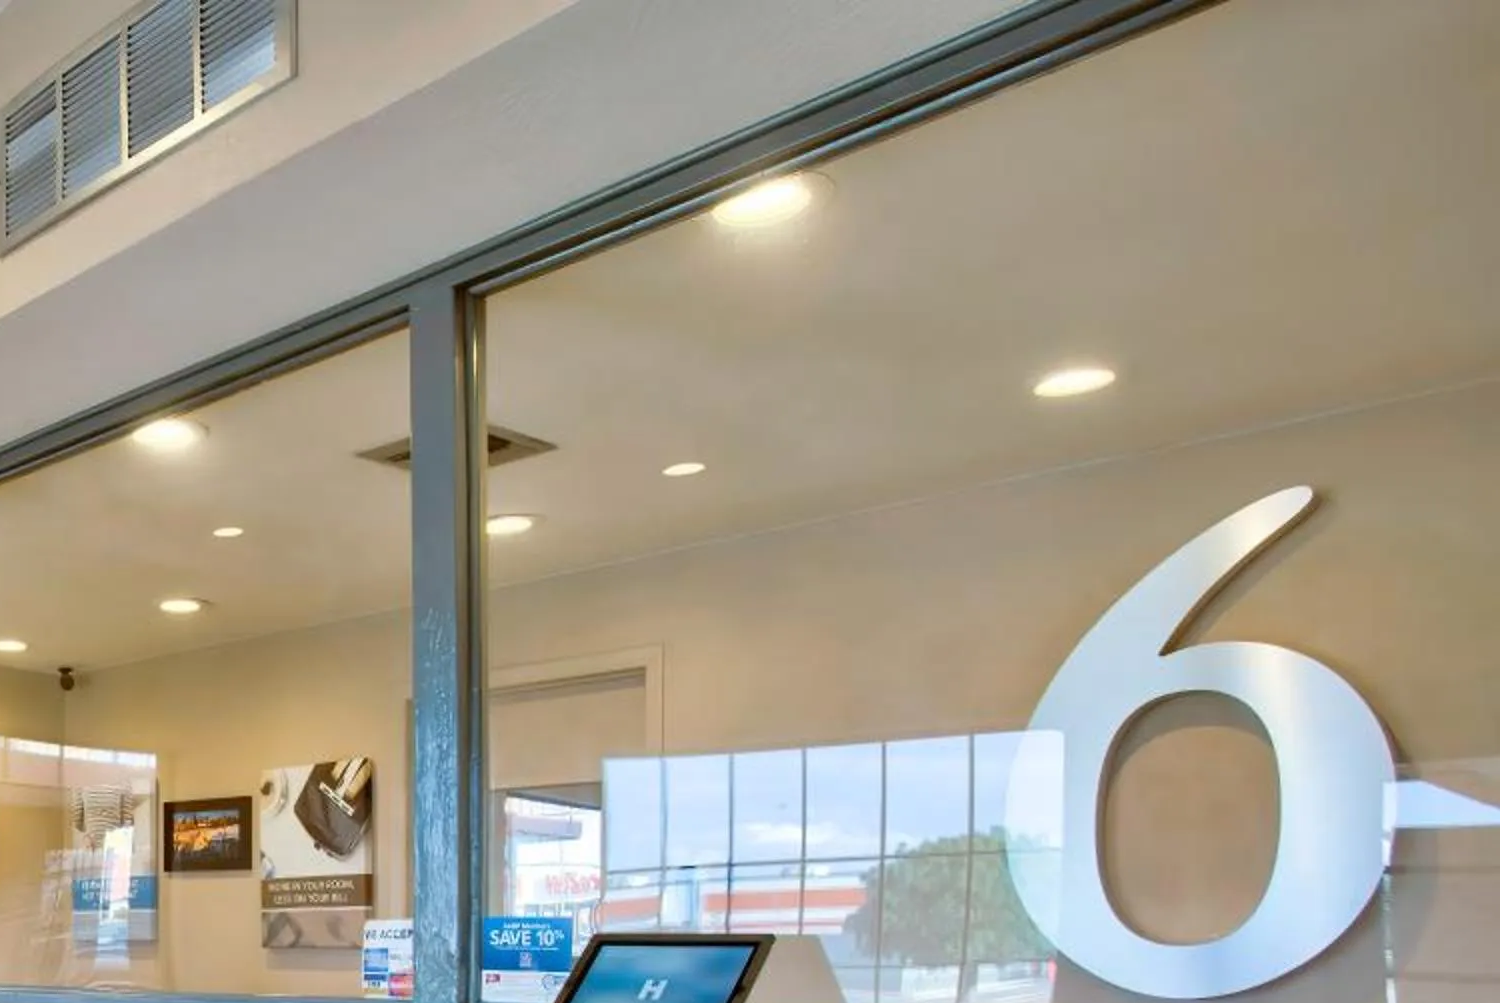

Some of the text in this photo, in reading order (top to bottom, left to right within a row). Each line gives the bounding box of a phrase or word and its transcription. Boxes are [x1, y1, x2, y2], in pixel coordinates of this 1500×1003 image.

[1004, 484, 1398, 1000] 6
[490, 929, 531, 946] SAVE
[637, 979, 669, 1001] H
